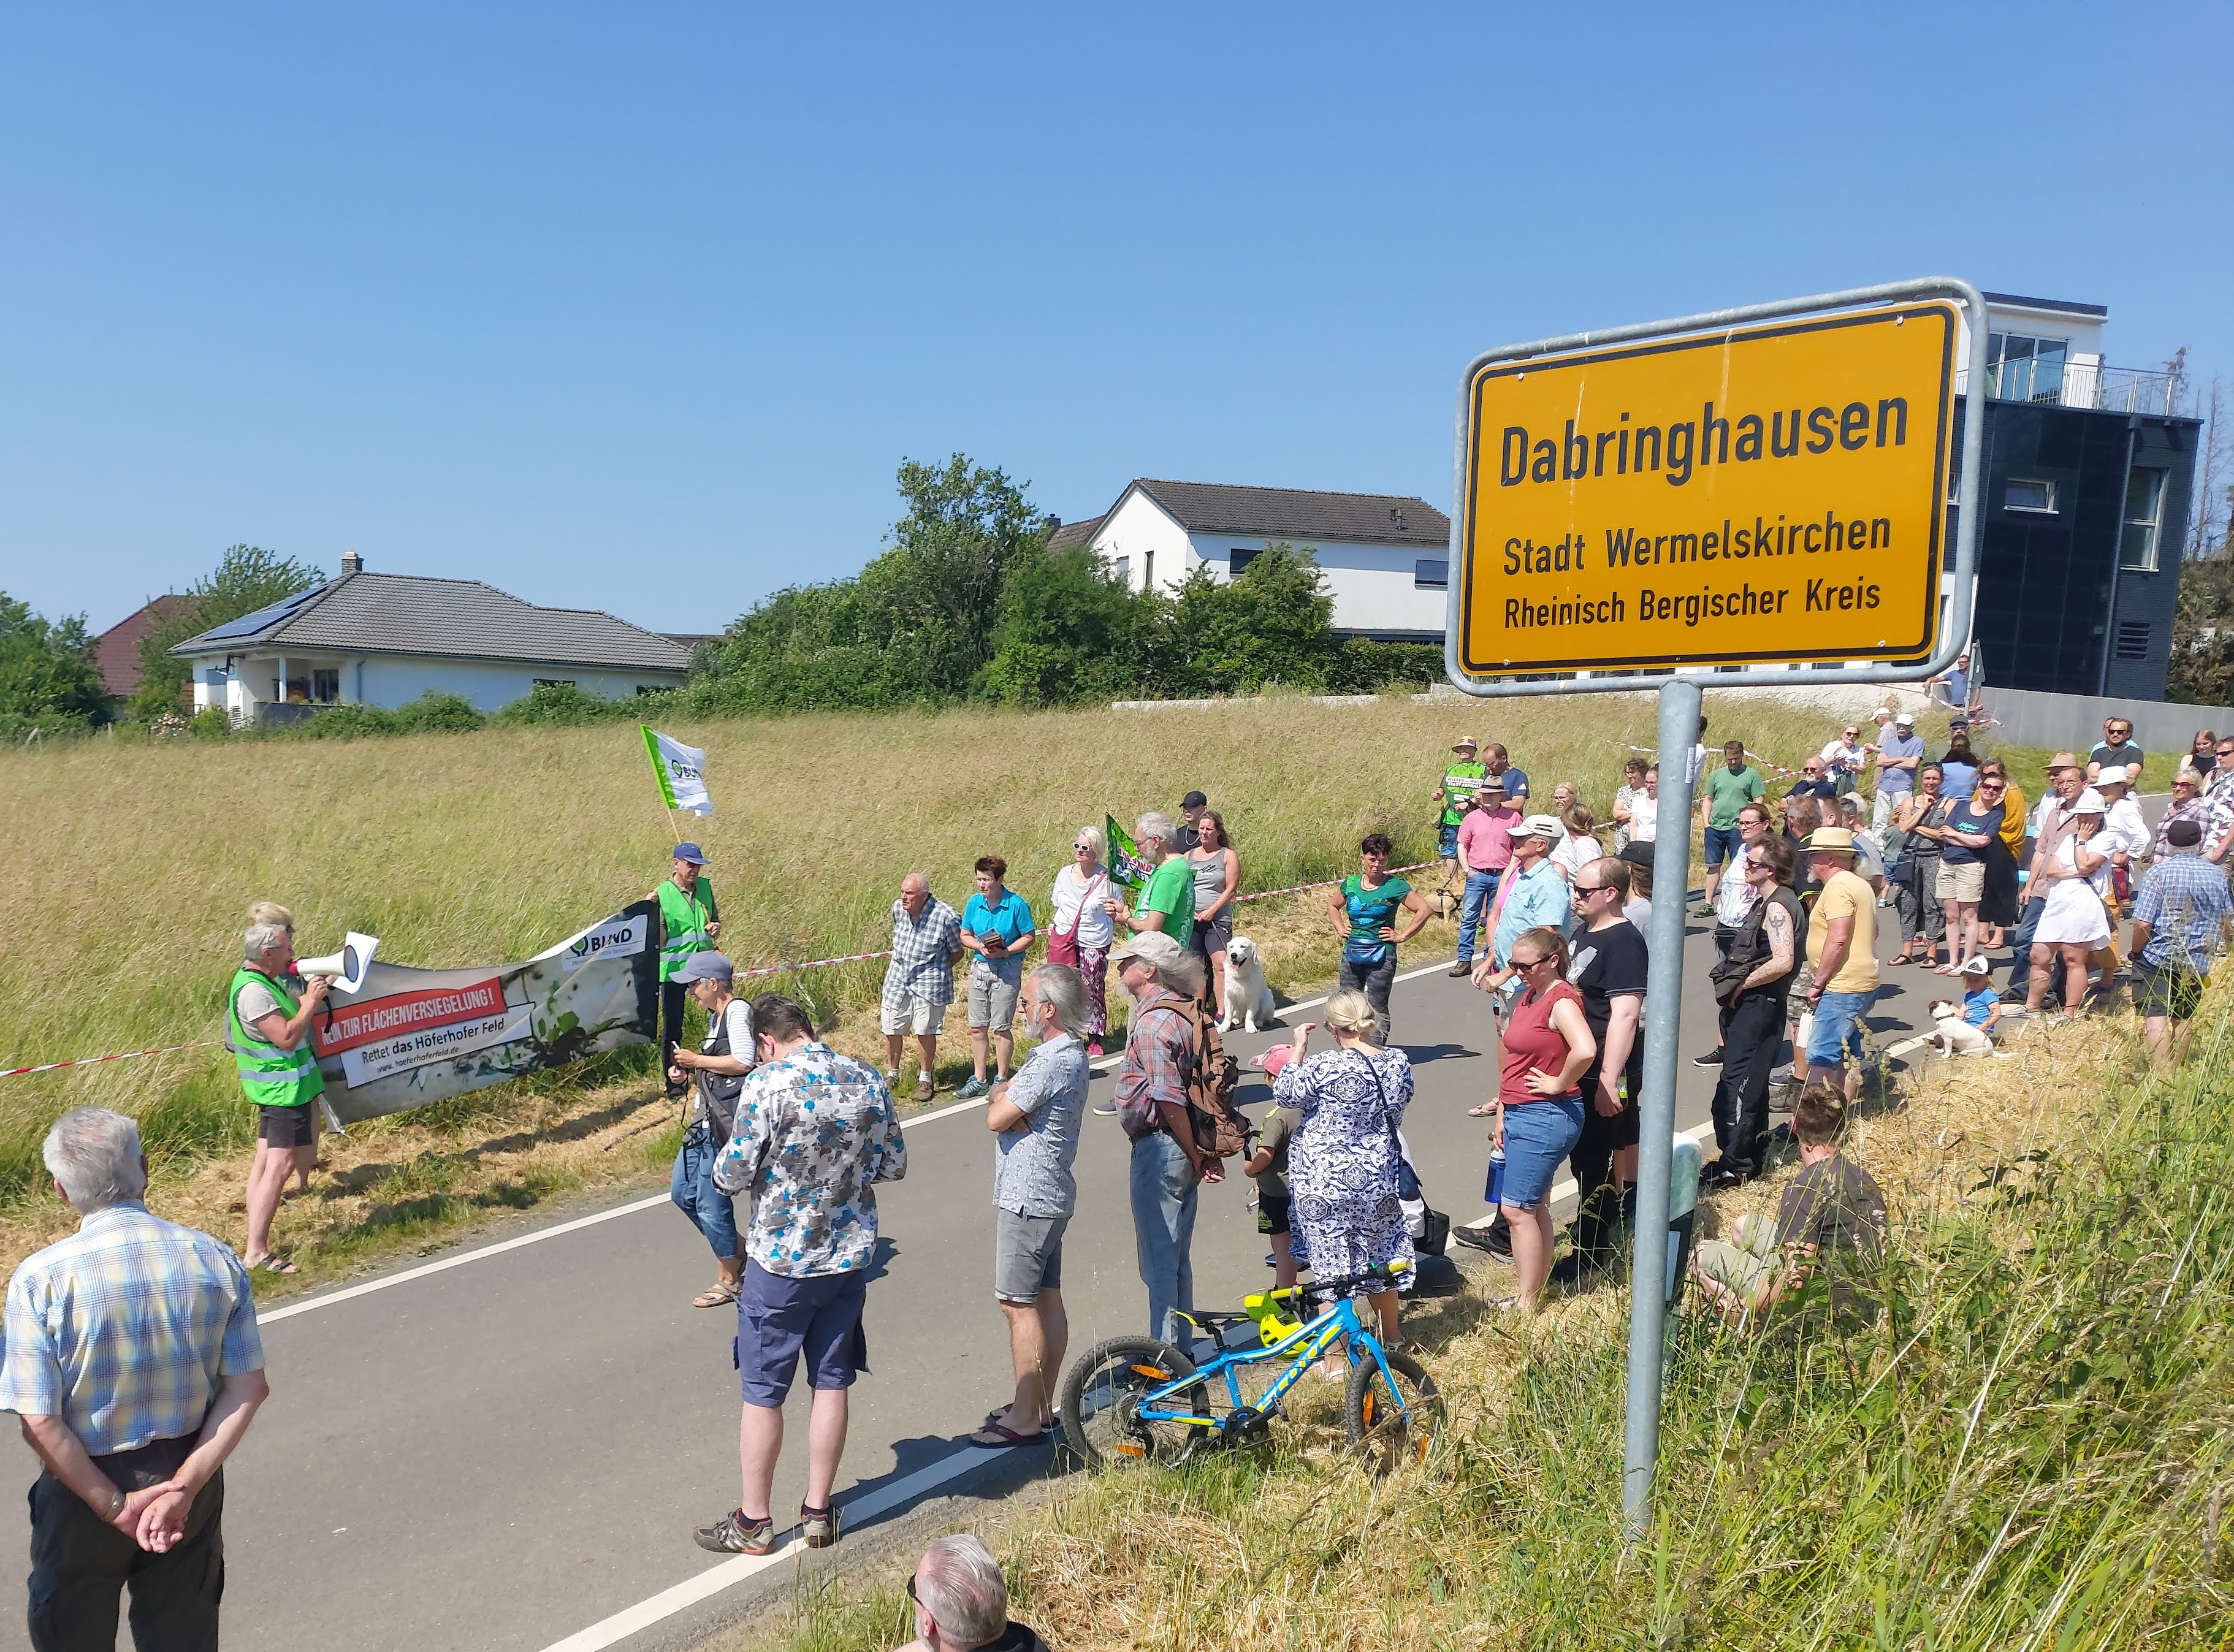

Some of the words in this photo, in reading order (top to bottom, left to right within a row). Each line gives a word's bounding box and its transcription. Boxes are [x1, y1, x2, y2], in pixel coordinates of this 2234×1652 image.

[1500, 397, 1908, 488] Dabringhausen
[1504, 533, 1586, 576] Stadt
[1606, 511, 1890, 568] Wermelskirchen
[1504, 592, 1625, 628] Rheinisch
[1639, 582, 1789, 628] Bergischer
[1804, 577, 1881, 612] Kreis
[341, 1017, 373, 1040] ZUR
[362, 1045, 391, 1064] Rettet
[392, 1041, 413, 1054] das
[415, 1026, 479, 1049] Höferhofer
[482, 1018, 505, 1034] Feld
